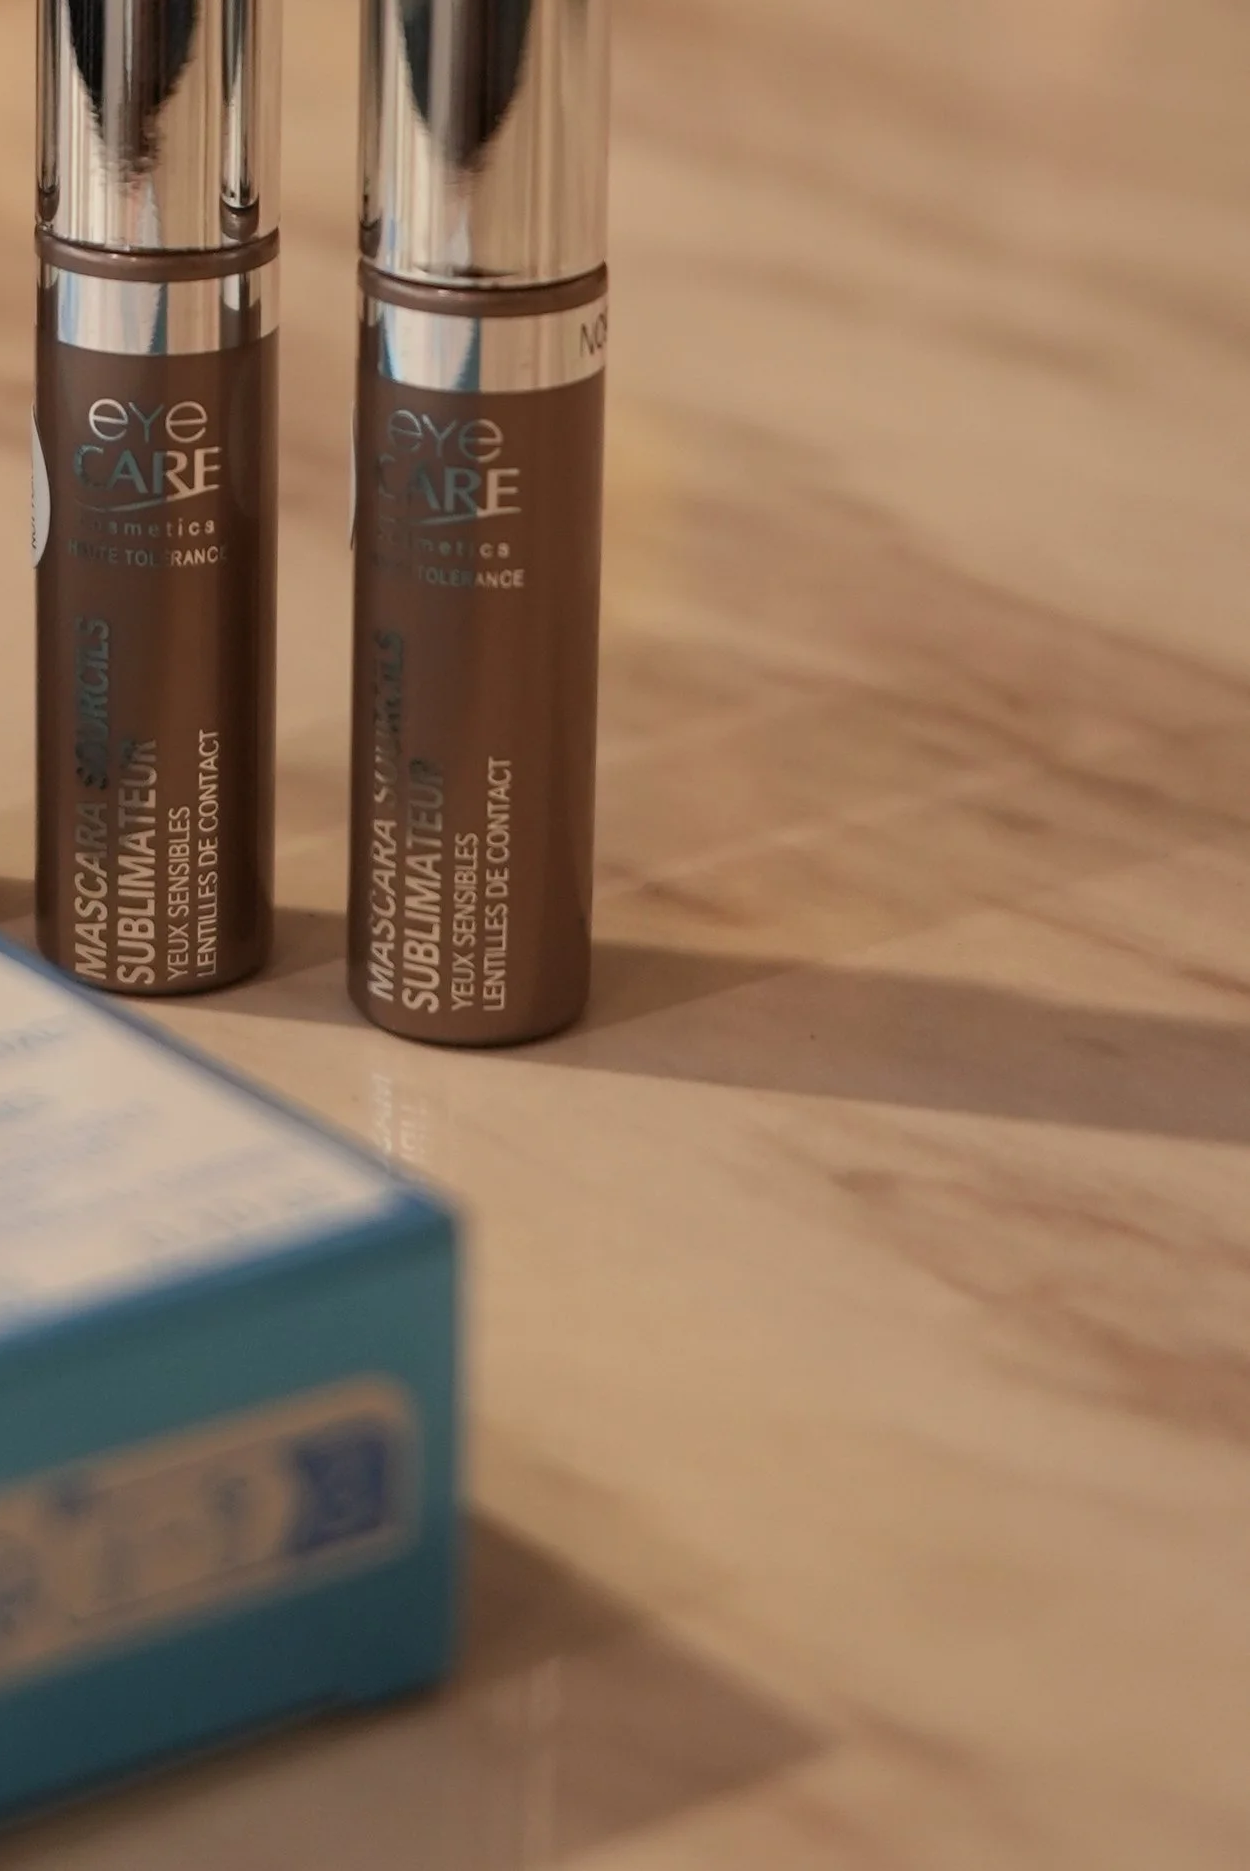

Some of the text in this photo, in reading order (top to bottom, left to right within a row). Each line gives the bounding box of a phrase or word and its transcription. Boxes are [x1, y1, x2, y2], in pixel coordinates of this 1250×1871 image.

[73, 443, 222, 500] CARE
[88, 397, 208, 444] eye
[380, 452, 522, 517] ARE
[387, 409, 504, 463] eye
[79, 517, 216, 539] osmetics
[73, 801, 109, 980] MASCARA
[116, 737, 158, 985] SUBLIMATEUR
[166, 806, 191, 982] YEUX SENSIBLES
[197, 728, 220, 978] LENTILLES DE CONTACT
[366, 818, 398, 1003] MASCARA
[401, 757, 444, 1014] SUBLIMATEUR
[450, 832, 479, 1012] YEUX SENSIBLES
[482, 755, 512, 1012] LENTILLES DE CONTACT
